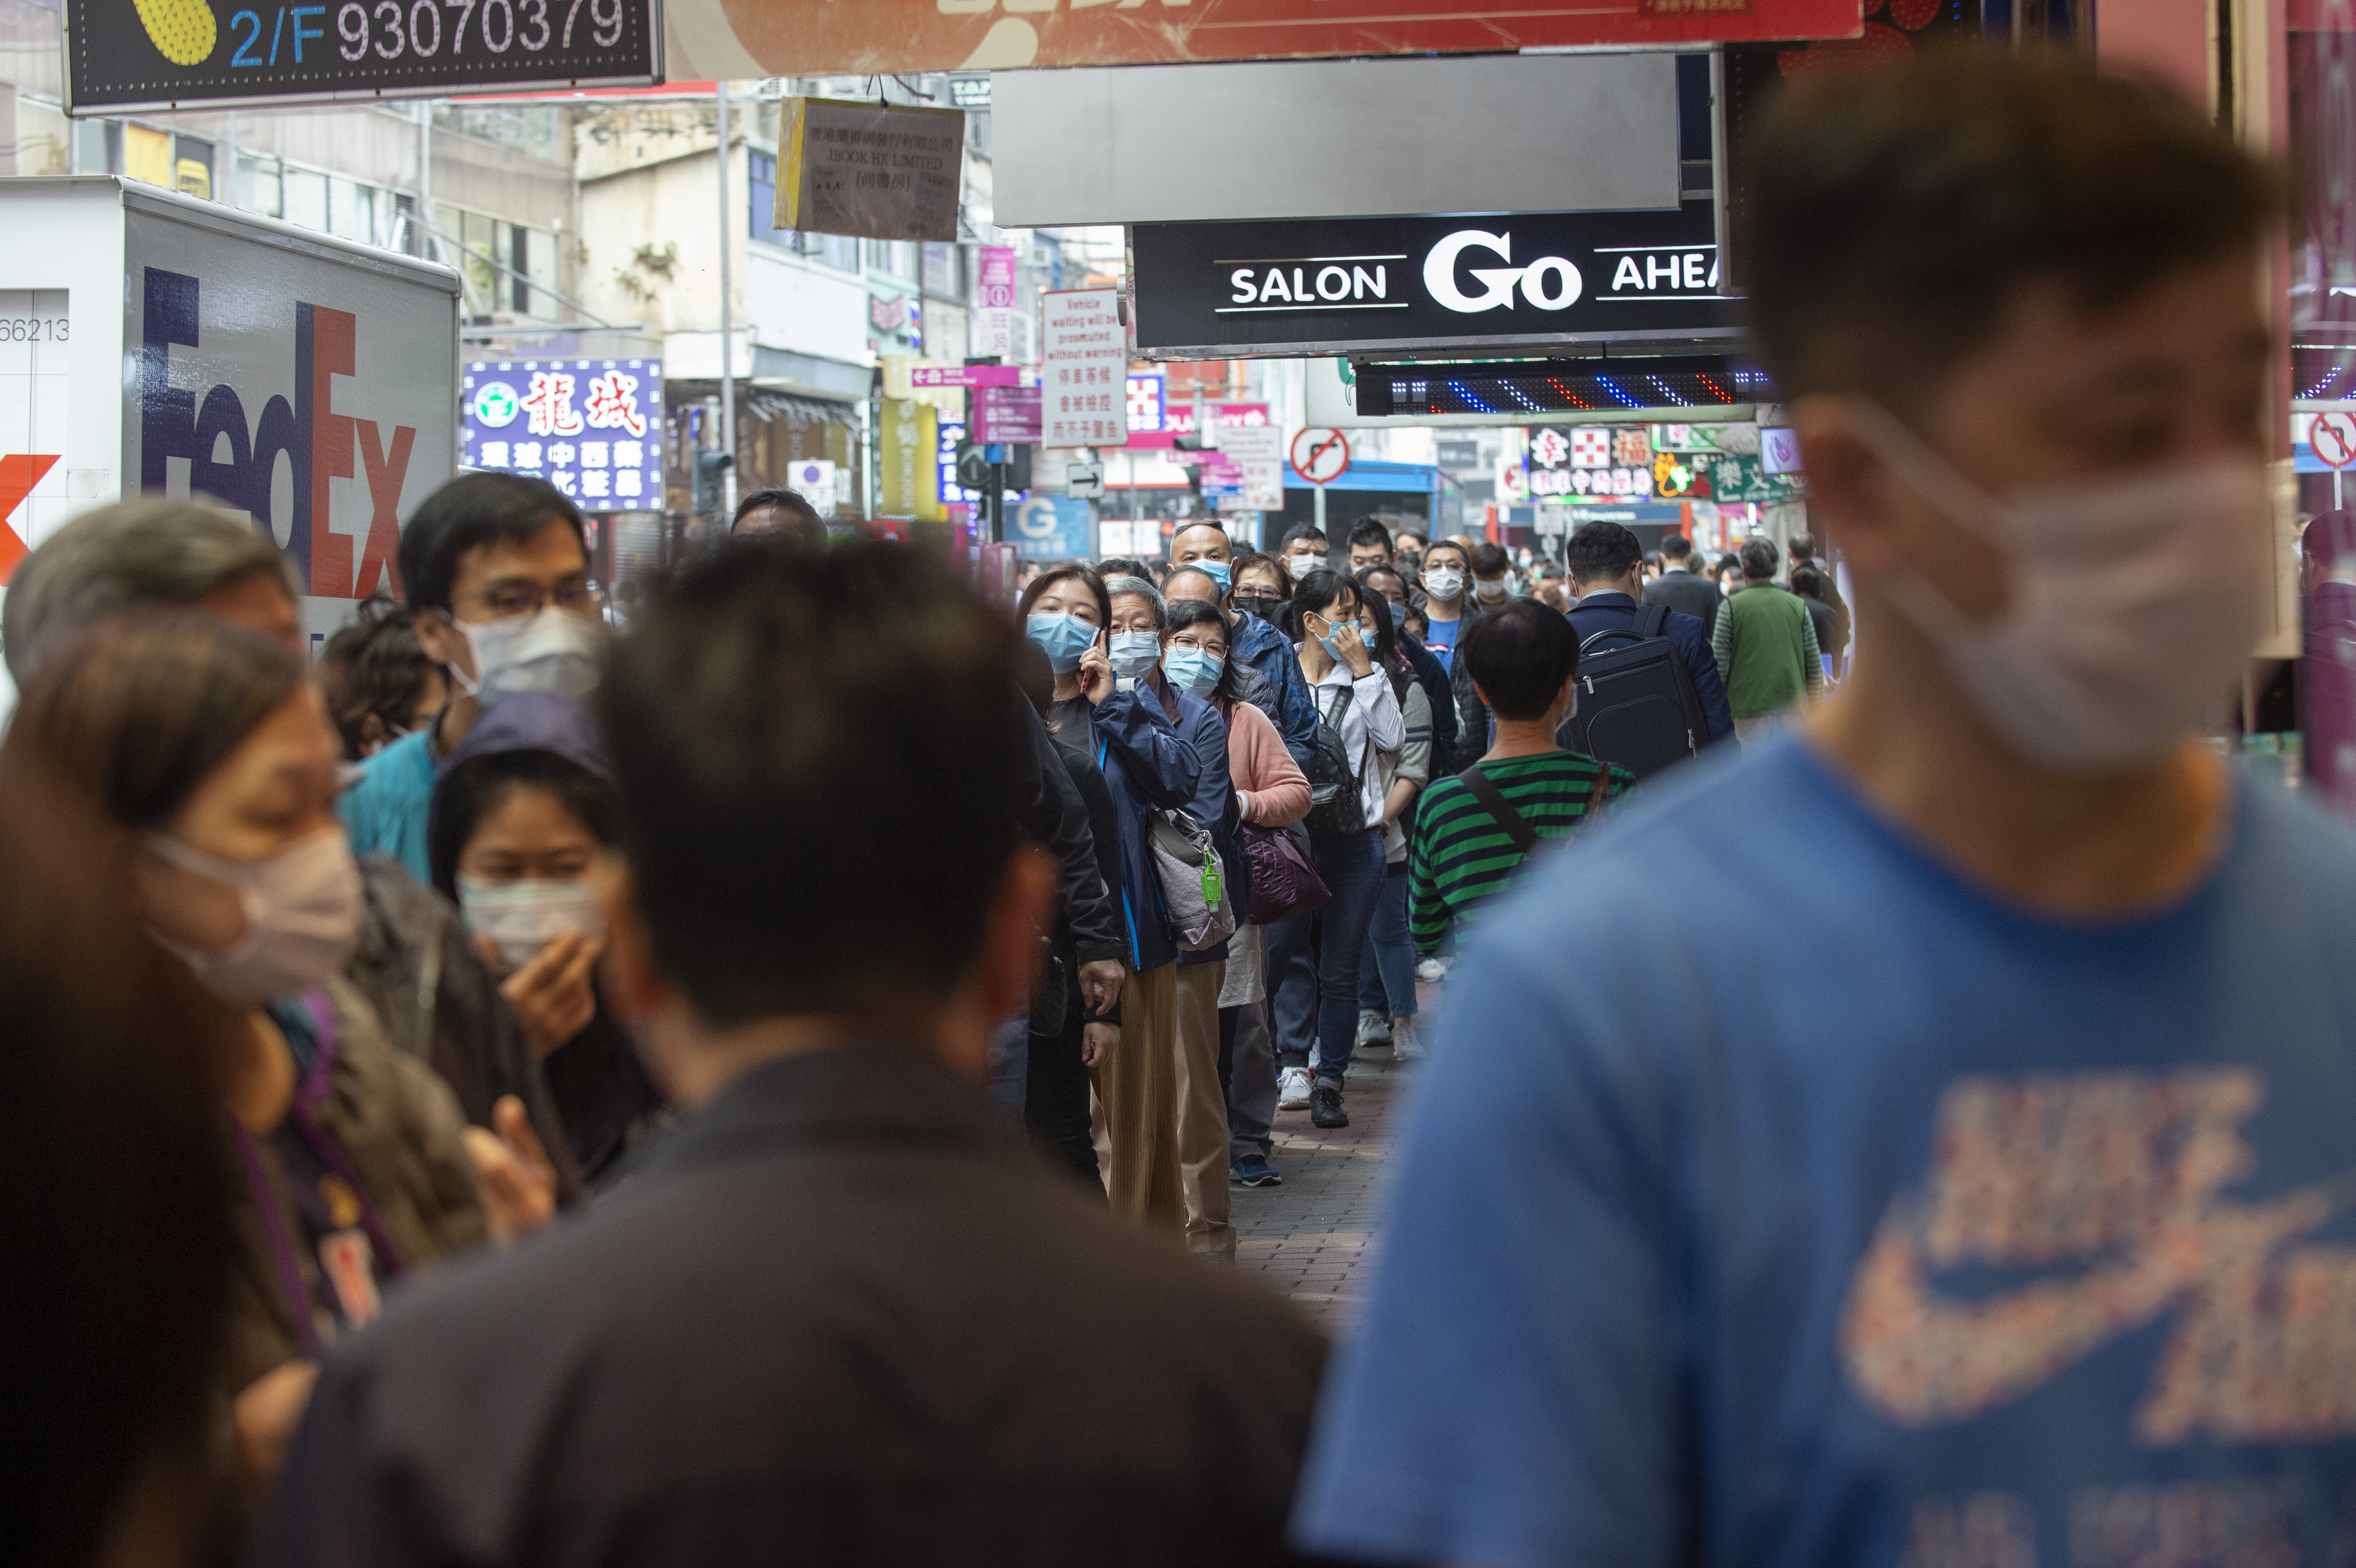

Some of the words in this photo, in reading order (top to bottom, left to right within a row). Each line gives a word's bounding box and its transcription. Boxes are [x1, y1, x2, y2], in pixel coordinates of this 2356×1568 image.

[231, 5, 325, 67] 2/F
[338, 0, 623, 61] 93070379
[828, 148, 868, 164] JBOOK
[892, 153, 943, 171] LIMITED
[1230, 265, 1387, 303] SALON
[1423, 230, 1583, 313] Go
[1048, 350, 1082, 360] without
[1086, 348, 1122, 359] warning
[1058, 330, 1110, 344] prosecuted
[142, 266, 417, 599] FedEx
